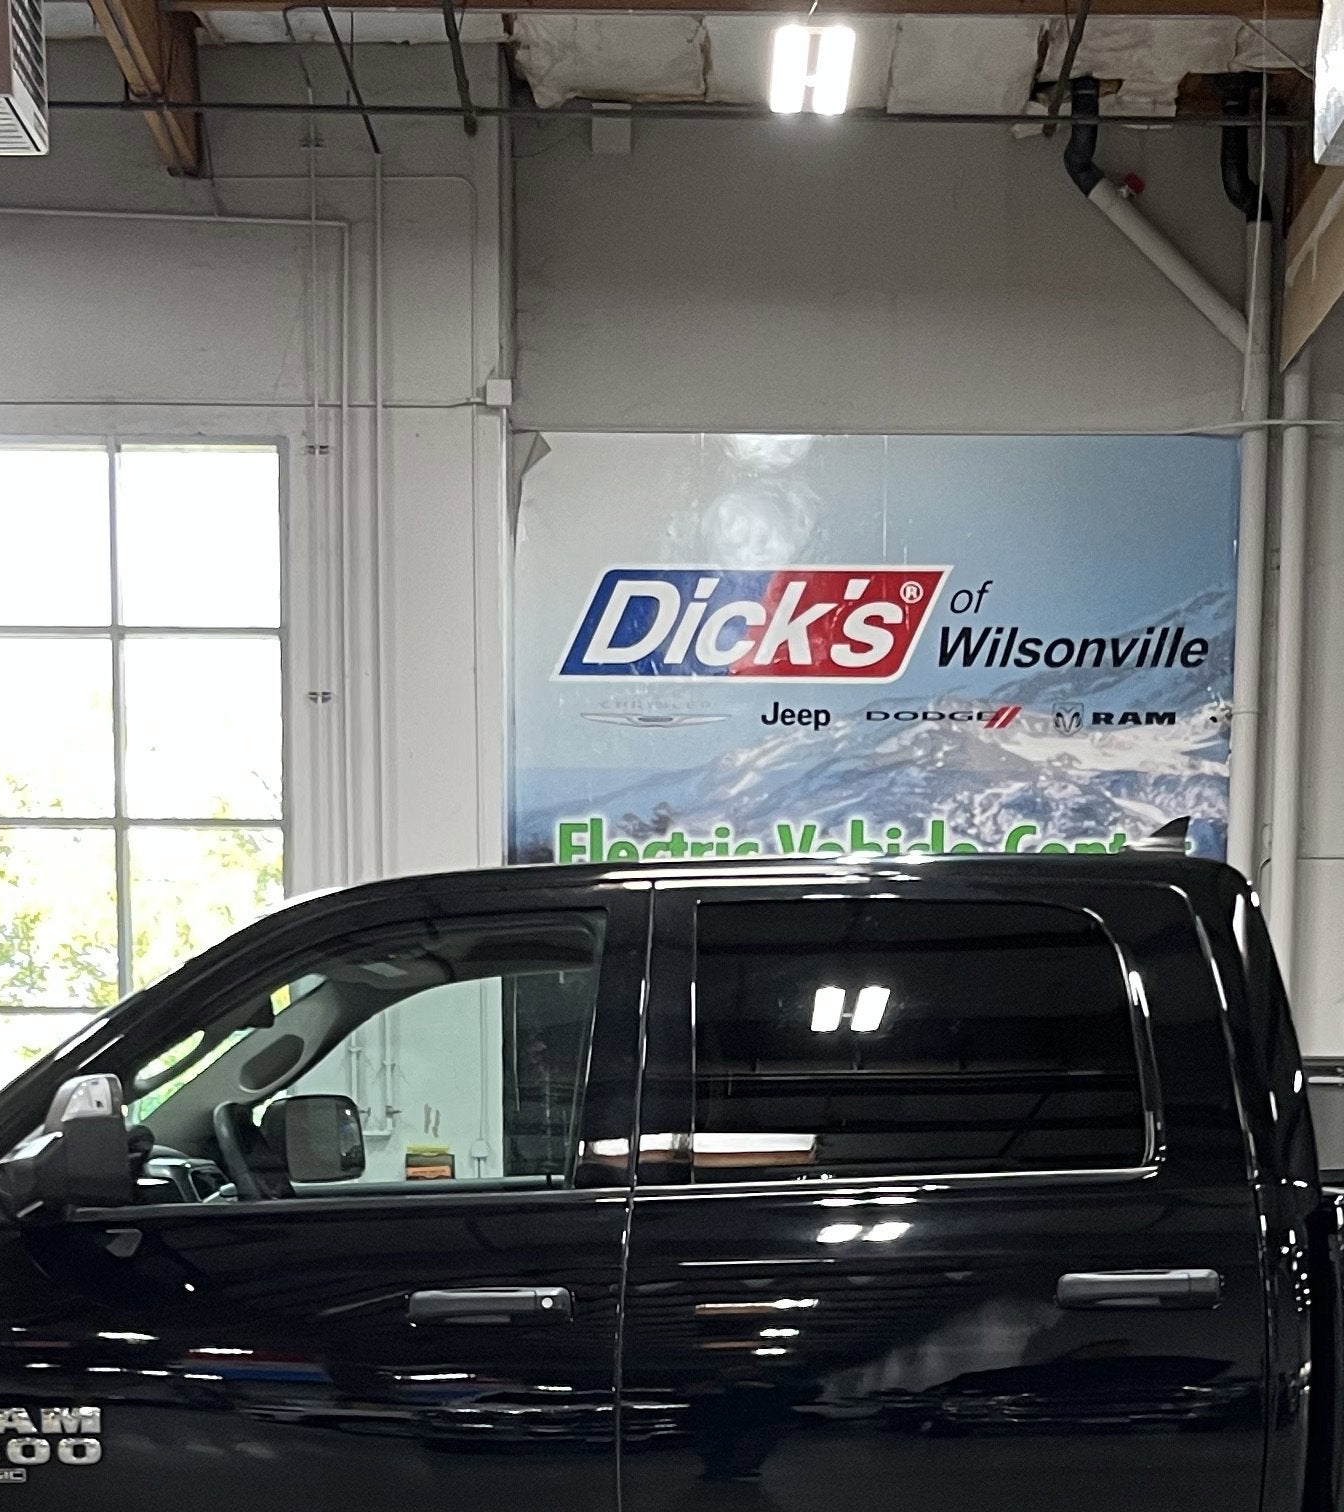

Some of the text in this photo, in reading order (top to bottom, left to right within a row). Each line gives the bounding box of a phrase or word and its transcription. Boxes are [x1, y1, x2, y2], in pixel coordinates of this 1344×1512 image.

[950, 579, 994, 614] of
[937, 626, 1209, 669] Wilsonville
[761, 701, 831, 731] Jeep
[865, 710, 999, 722] DODGE
[1092, 711, 1177, 726] RAM
